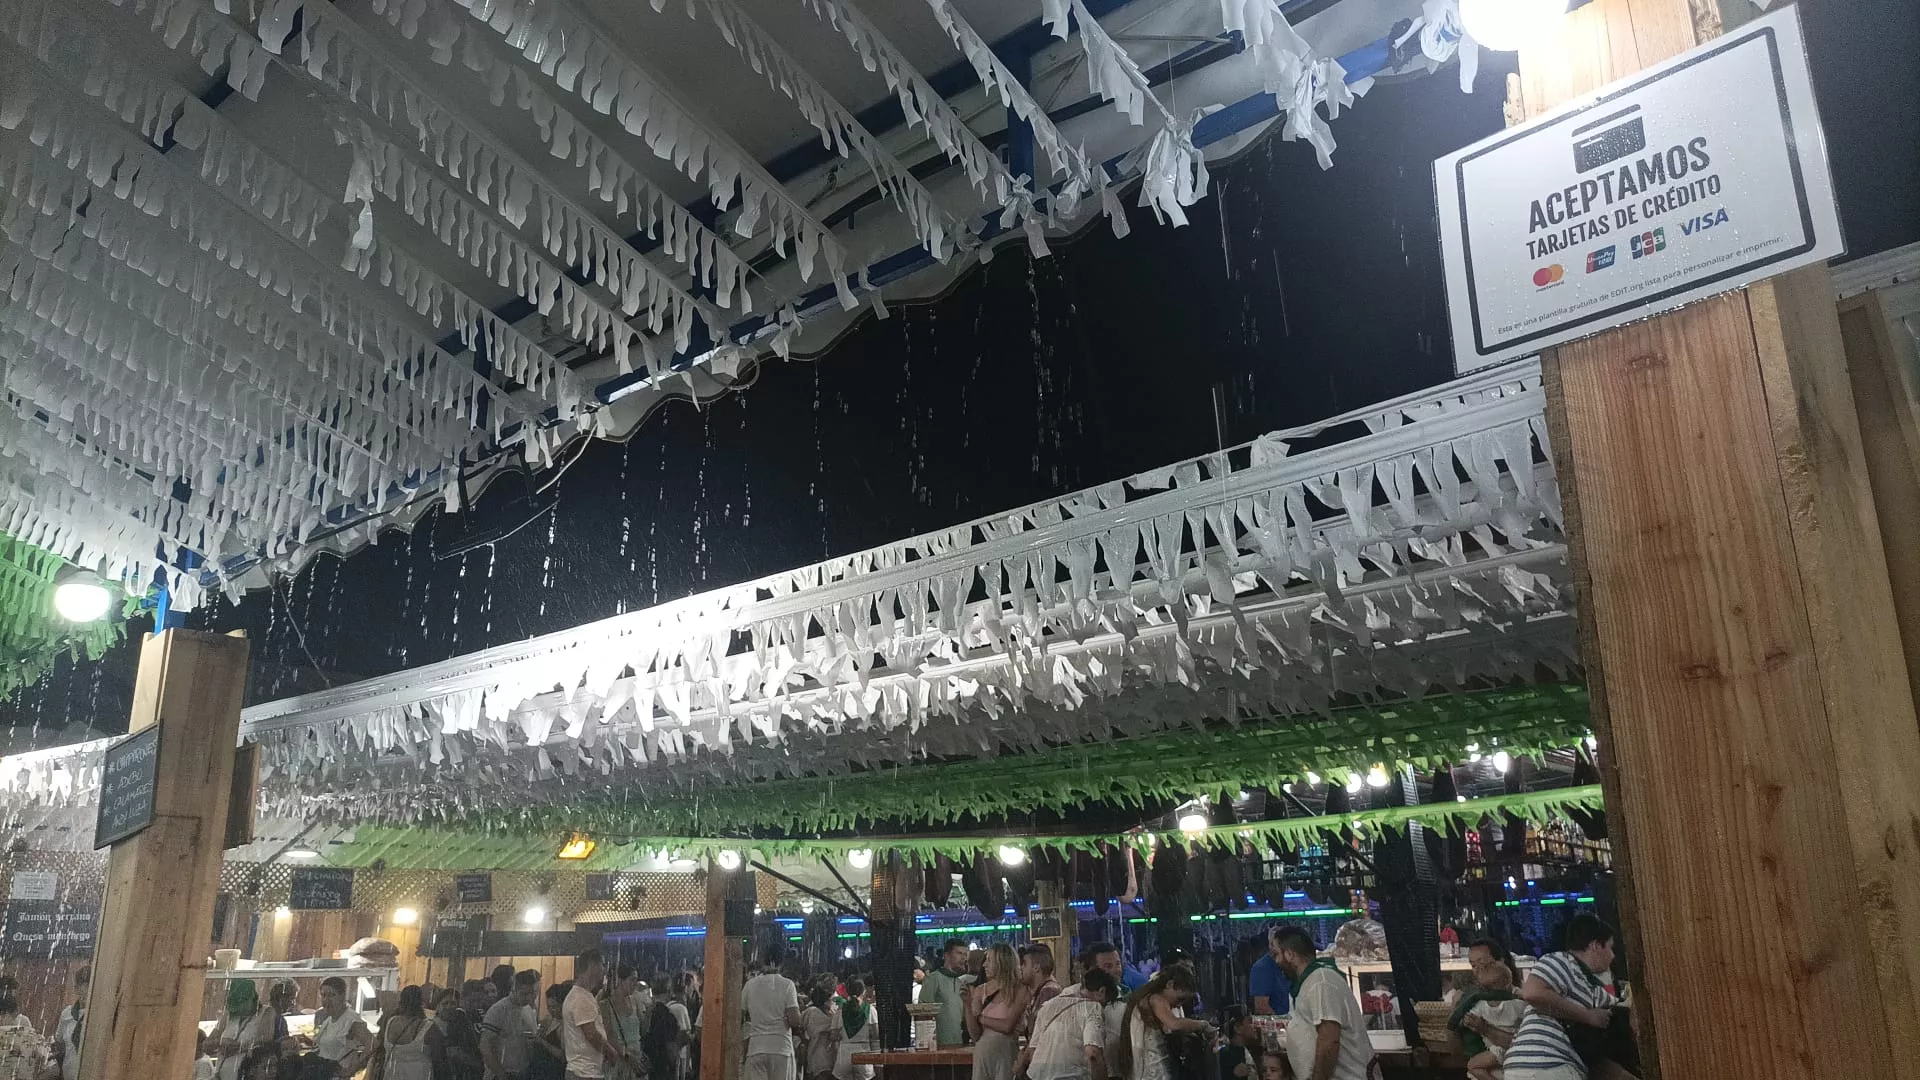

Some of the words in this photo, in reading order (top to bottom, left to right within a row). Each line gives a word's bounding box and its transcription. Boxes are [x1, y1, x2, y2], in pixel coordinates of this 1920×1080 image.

[1526, 215, 1610, 260] TARJETAS
[1614, 204, 1638, 230] DE
[1642, 174, 1721, 219] CRÉDITO
[1529, 136, 1711, 234] ACEPTAMOS
[1630, 226, 1667, 260] JCB
[1679, 208, 1729, 236] VISA
[1498, 325, 1513, 335] Esta
[1523, 317, 1538, 327] una
[1538, 307, 1568, 323] plantilla
[1569, 297, 1598, 313] gratuita
[1599, 293, 1609, 302] de
[1610, 281, 1644, 298] EDIT.org
[1645, 276, 1661, 288] lista
[1662, 270, 1682, 282] para
[1683, 251, 1734, 275] personalizar
